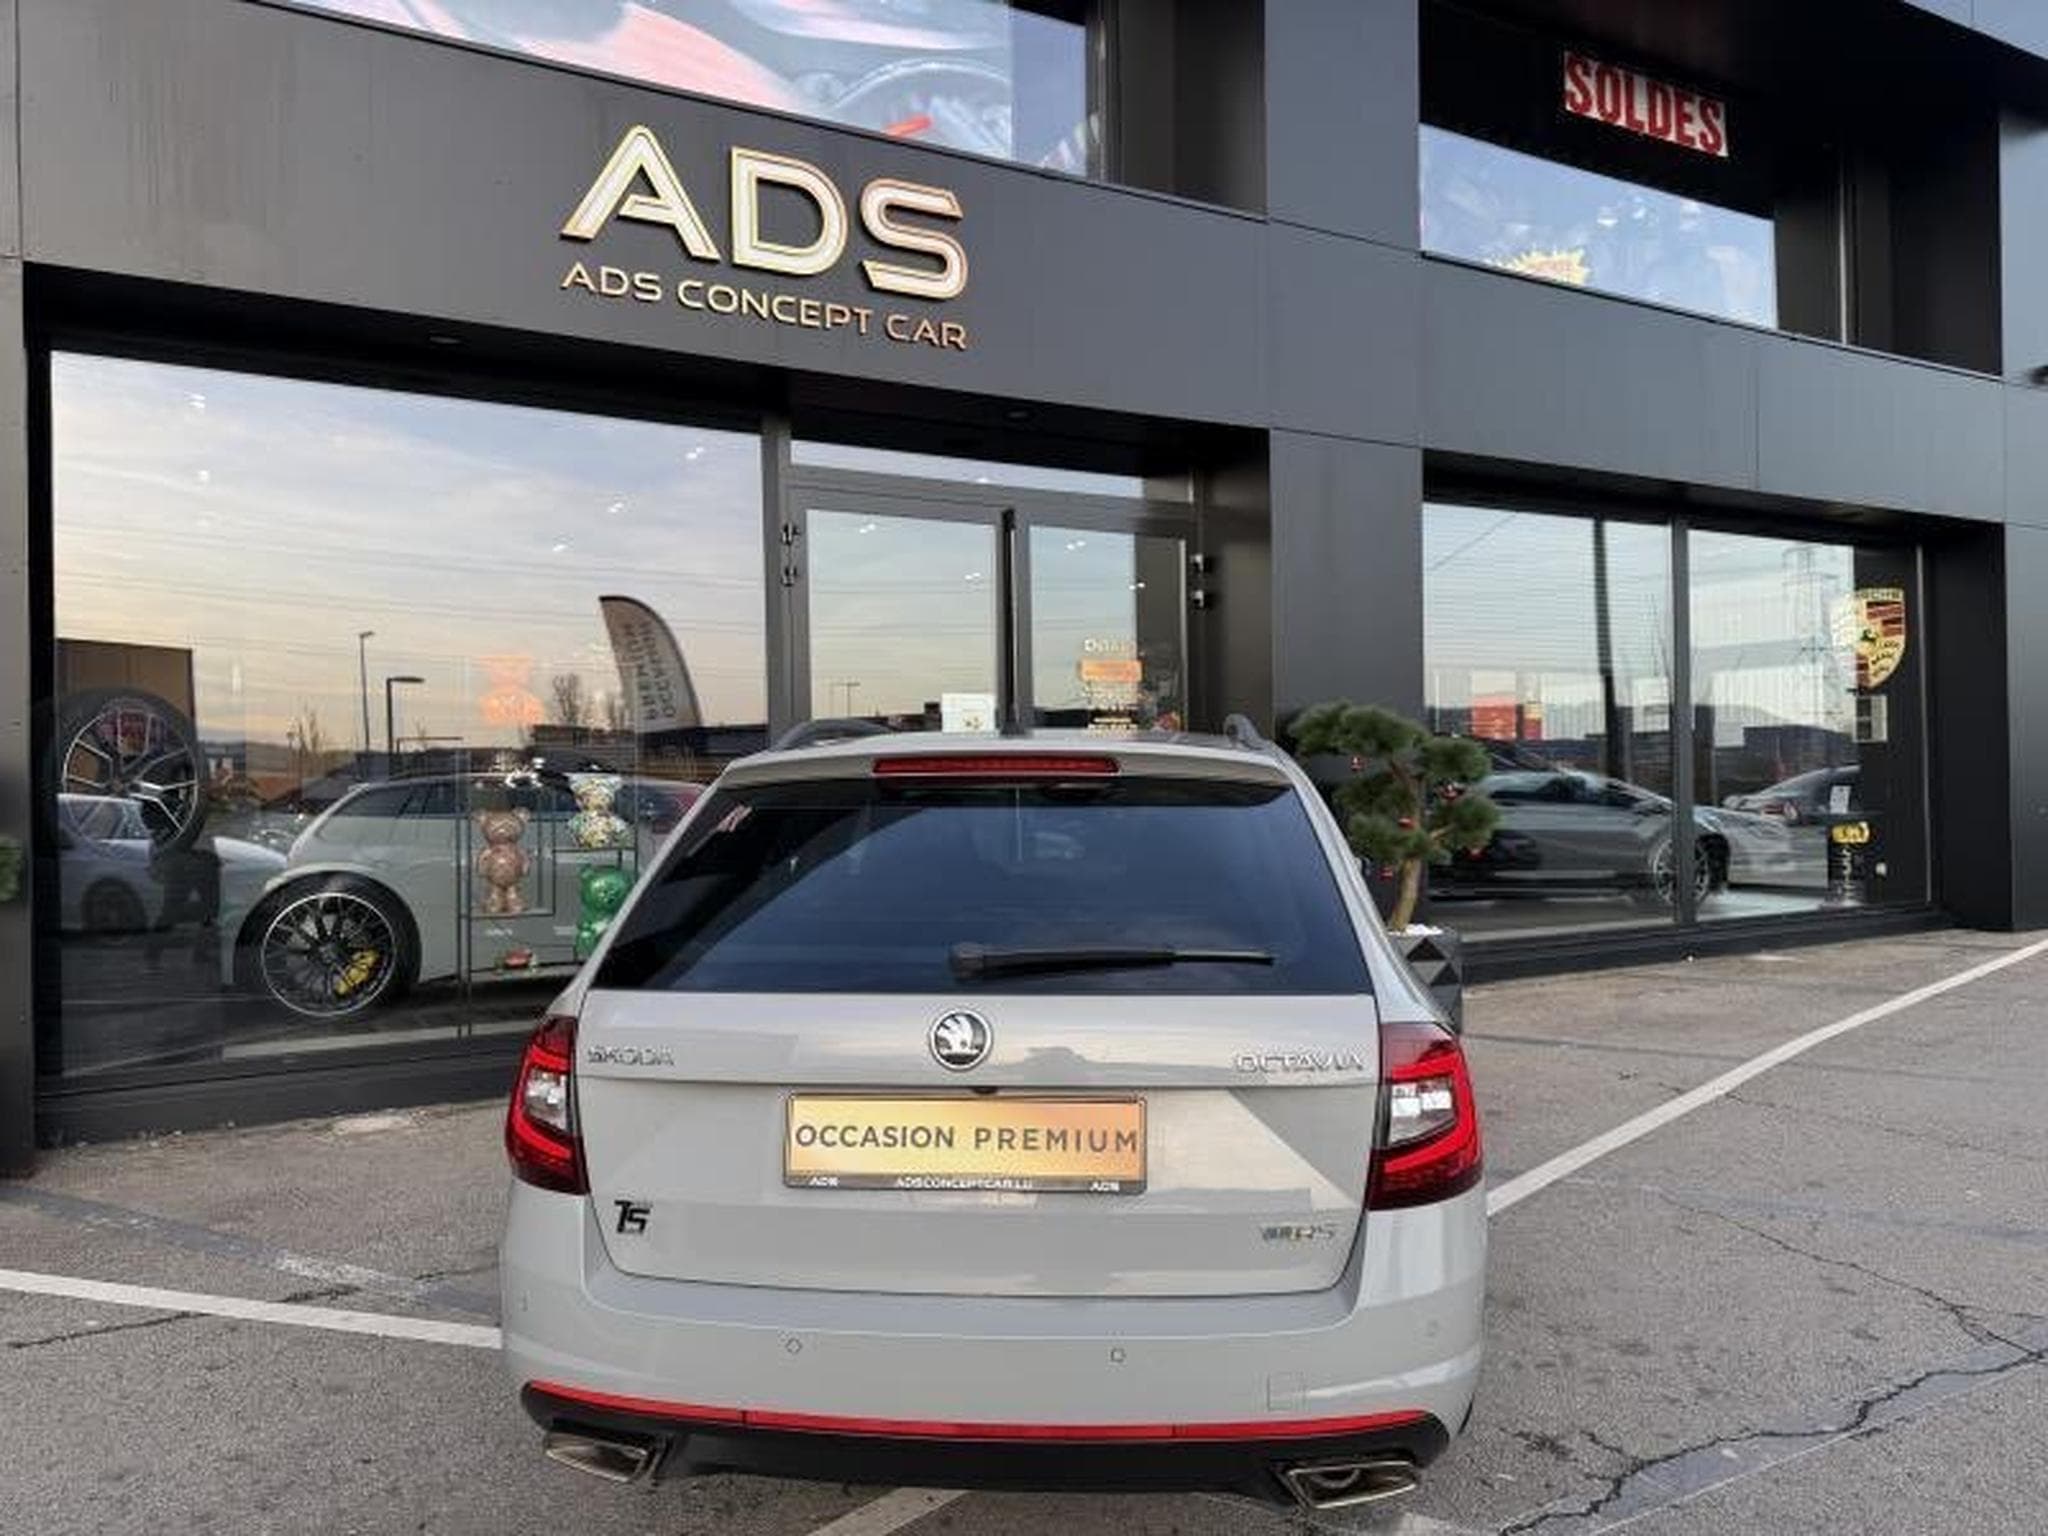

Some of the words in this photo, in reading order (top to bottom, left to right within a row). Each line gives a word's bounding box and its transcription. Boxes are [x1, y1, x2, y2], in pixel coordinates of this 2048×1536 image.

[1565, 54, 1724, 157] SOLDES
[560, 124, 970, 299] ADS
[561, 261, 663, 301] ADS
[677, 279, 874, 334] CONCEPT
[884, 312, 968, 350] CAR
[795, 1124, 955, 1149] OCCASION
[974, 1127, 1138, 1153] PREMIUM
